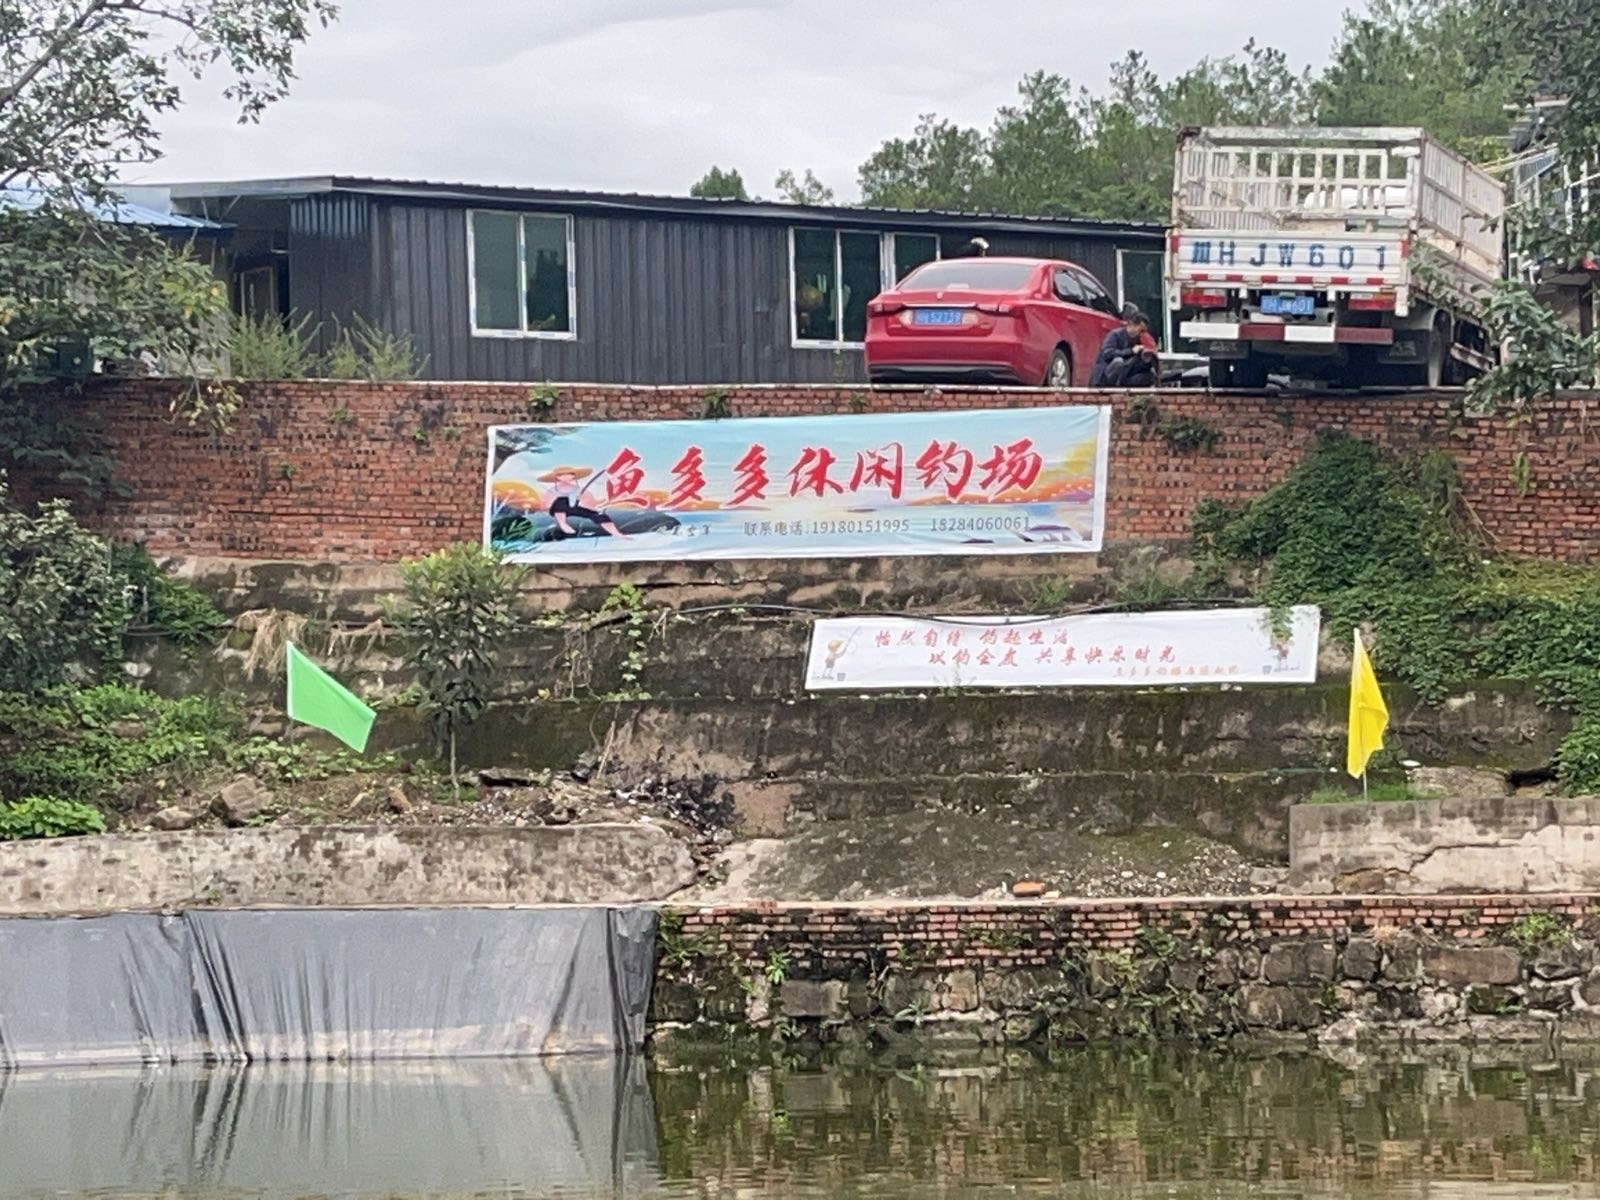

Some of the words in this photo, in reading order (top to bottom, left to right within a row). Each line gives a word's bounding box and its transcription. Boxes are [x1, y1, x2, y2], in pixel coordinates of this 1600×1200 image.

[604, 438, 1043, 509] 鱼多多休闲钓场
